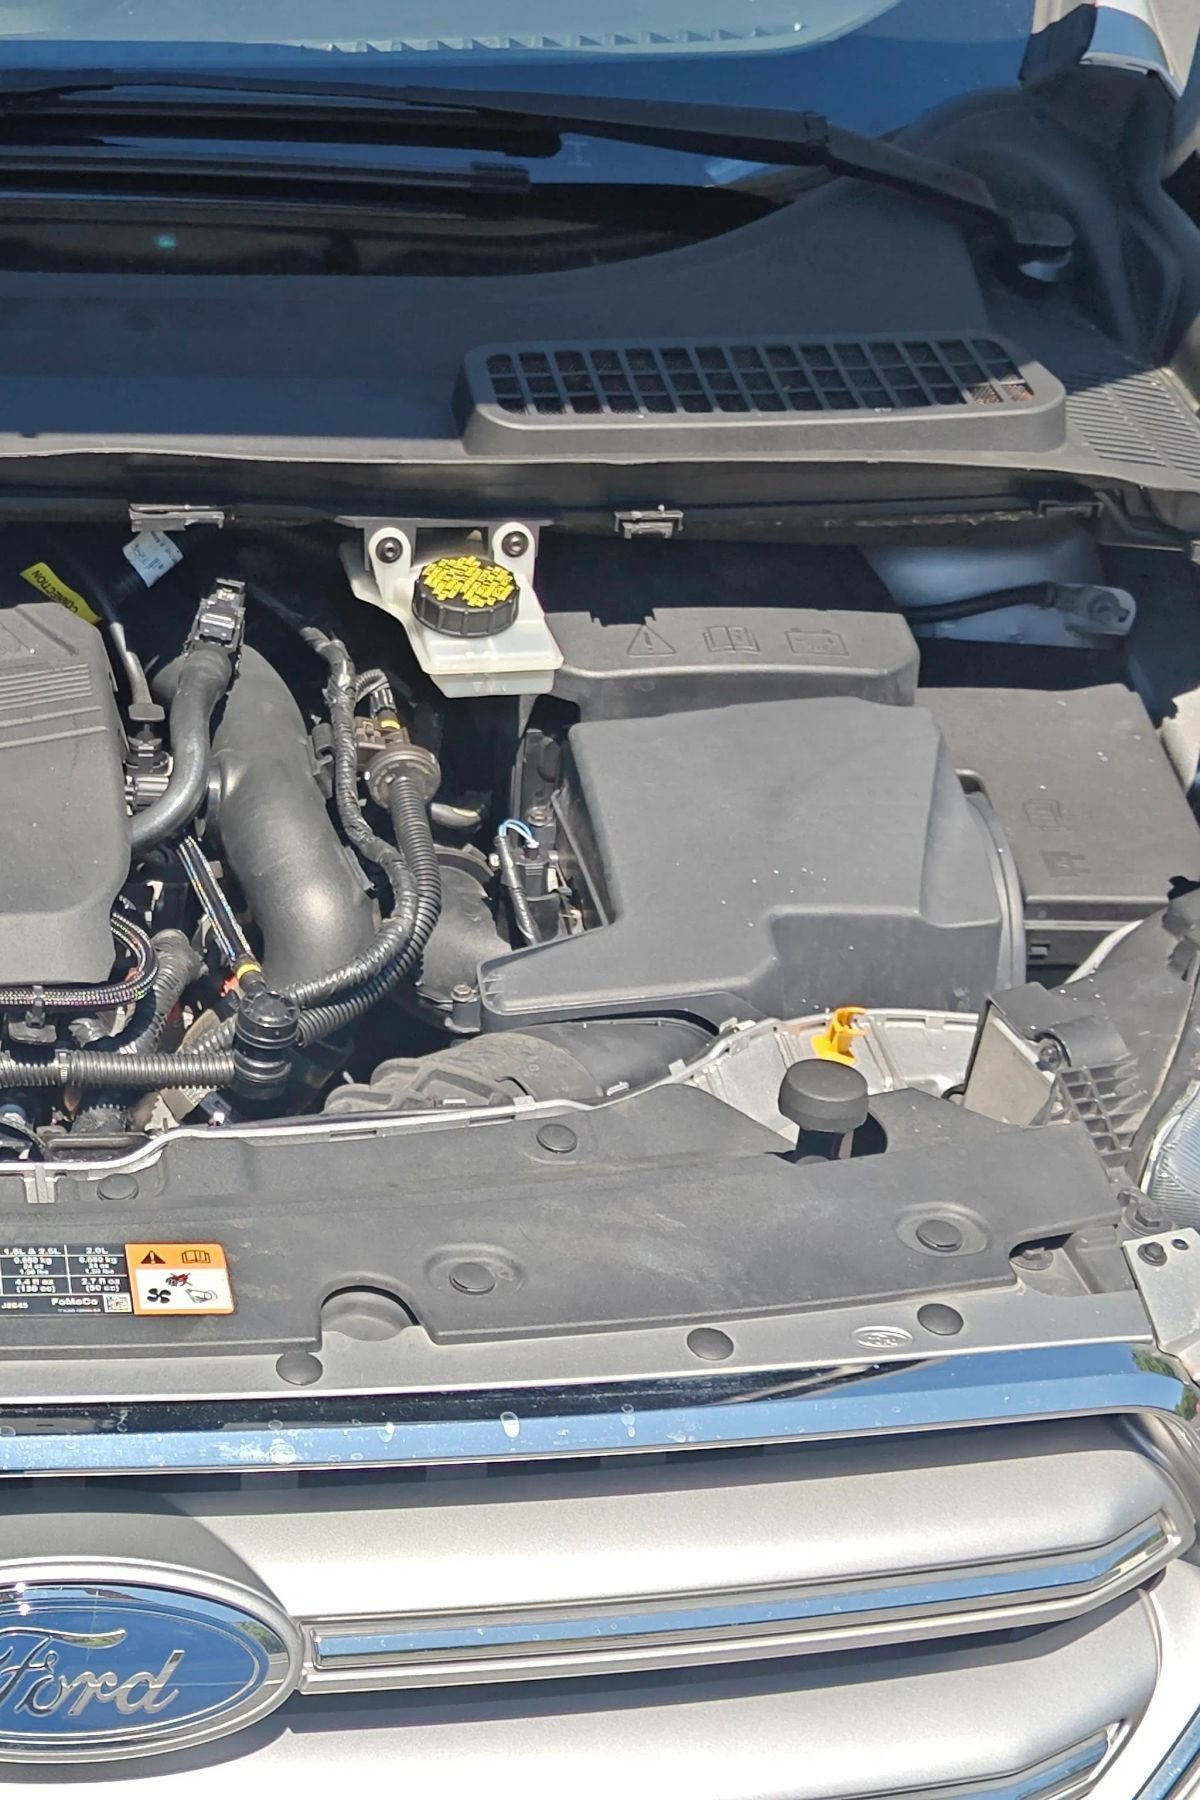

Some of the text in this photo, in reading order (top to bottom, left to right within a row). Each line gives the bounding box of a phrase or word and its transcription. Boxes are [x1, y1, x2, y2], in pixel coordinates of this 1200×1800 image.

[40, 1256, 53, 1266] kg
[105, 1256, 118, 1265] kg
[14, 1278, 31, 1286] 4.4
[81, 1277, 97, 1285] 2.7
[50, 1297, 99, 1307] FoMoCo
